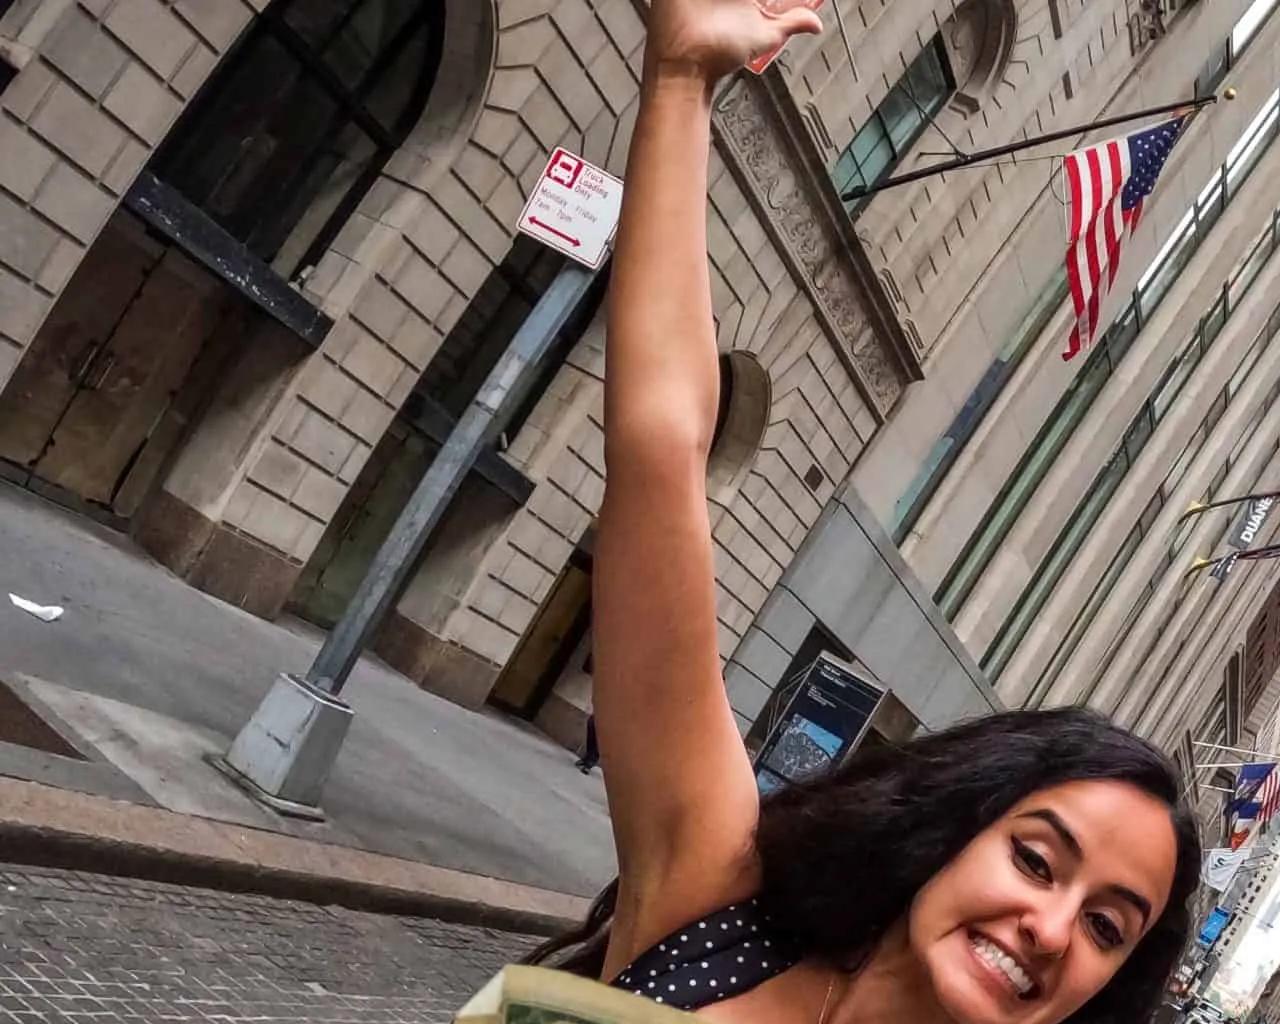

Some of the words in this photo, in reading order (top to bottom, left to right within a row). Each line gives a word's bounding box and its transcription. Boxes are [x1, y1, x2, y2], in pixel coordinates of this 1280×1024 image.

[584, 168, 604, 184] Truck
[579, 177, 609, 199] Loading
[1240, 497, 1273, 542] DUANE
